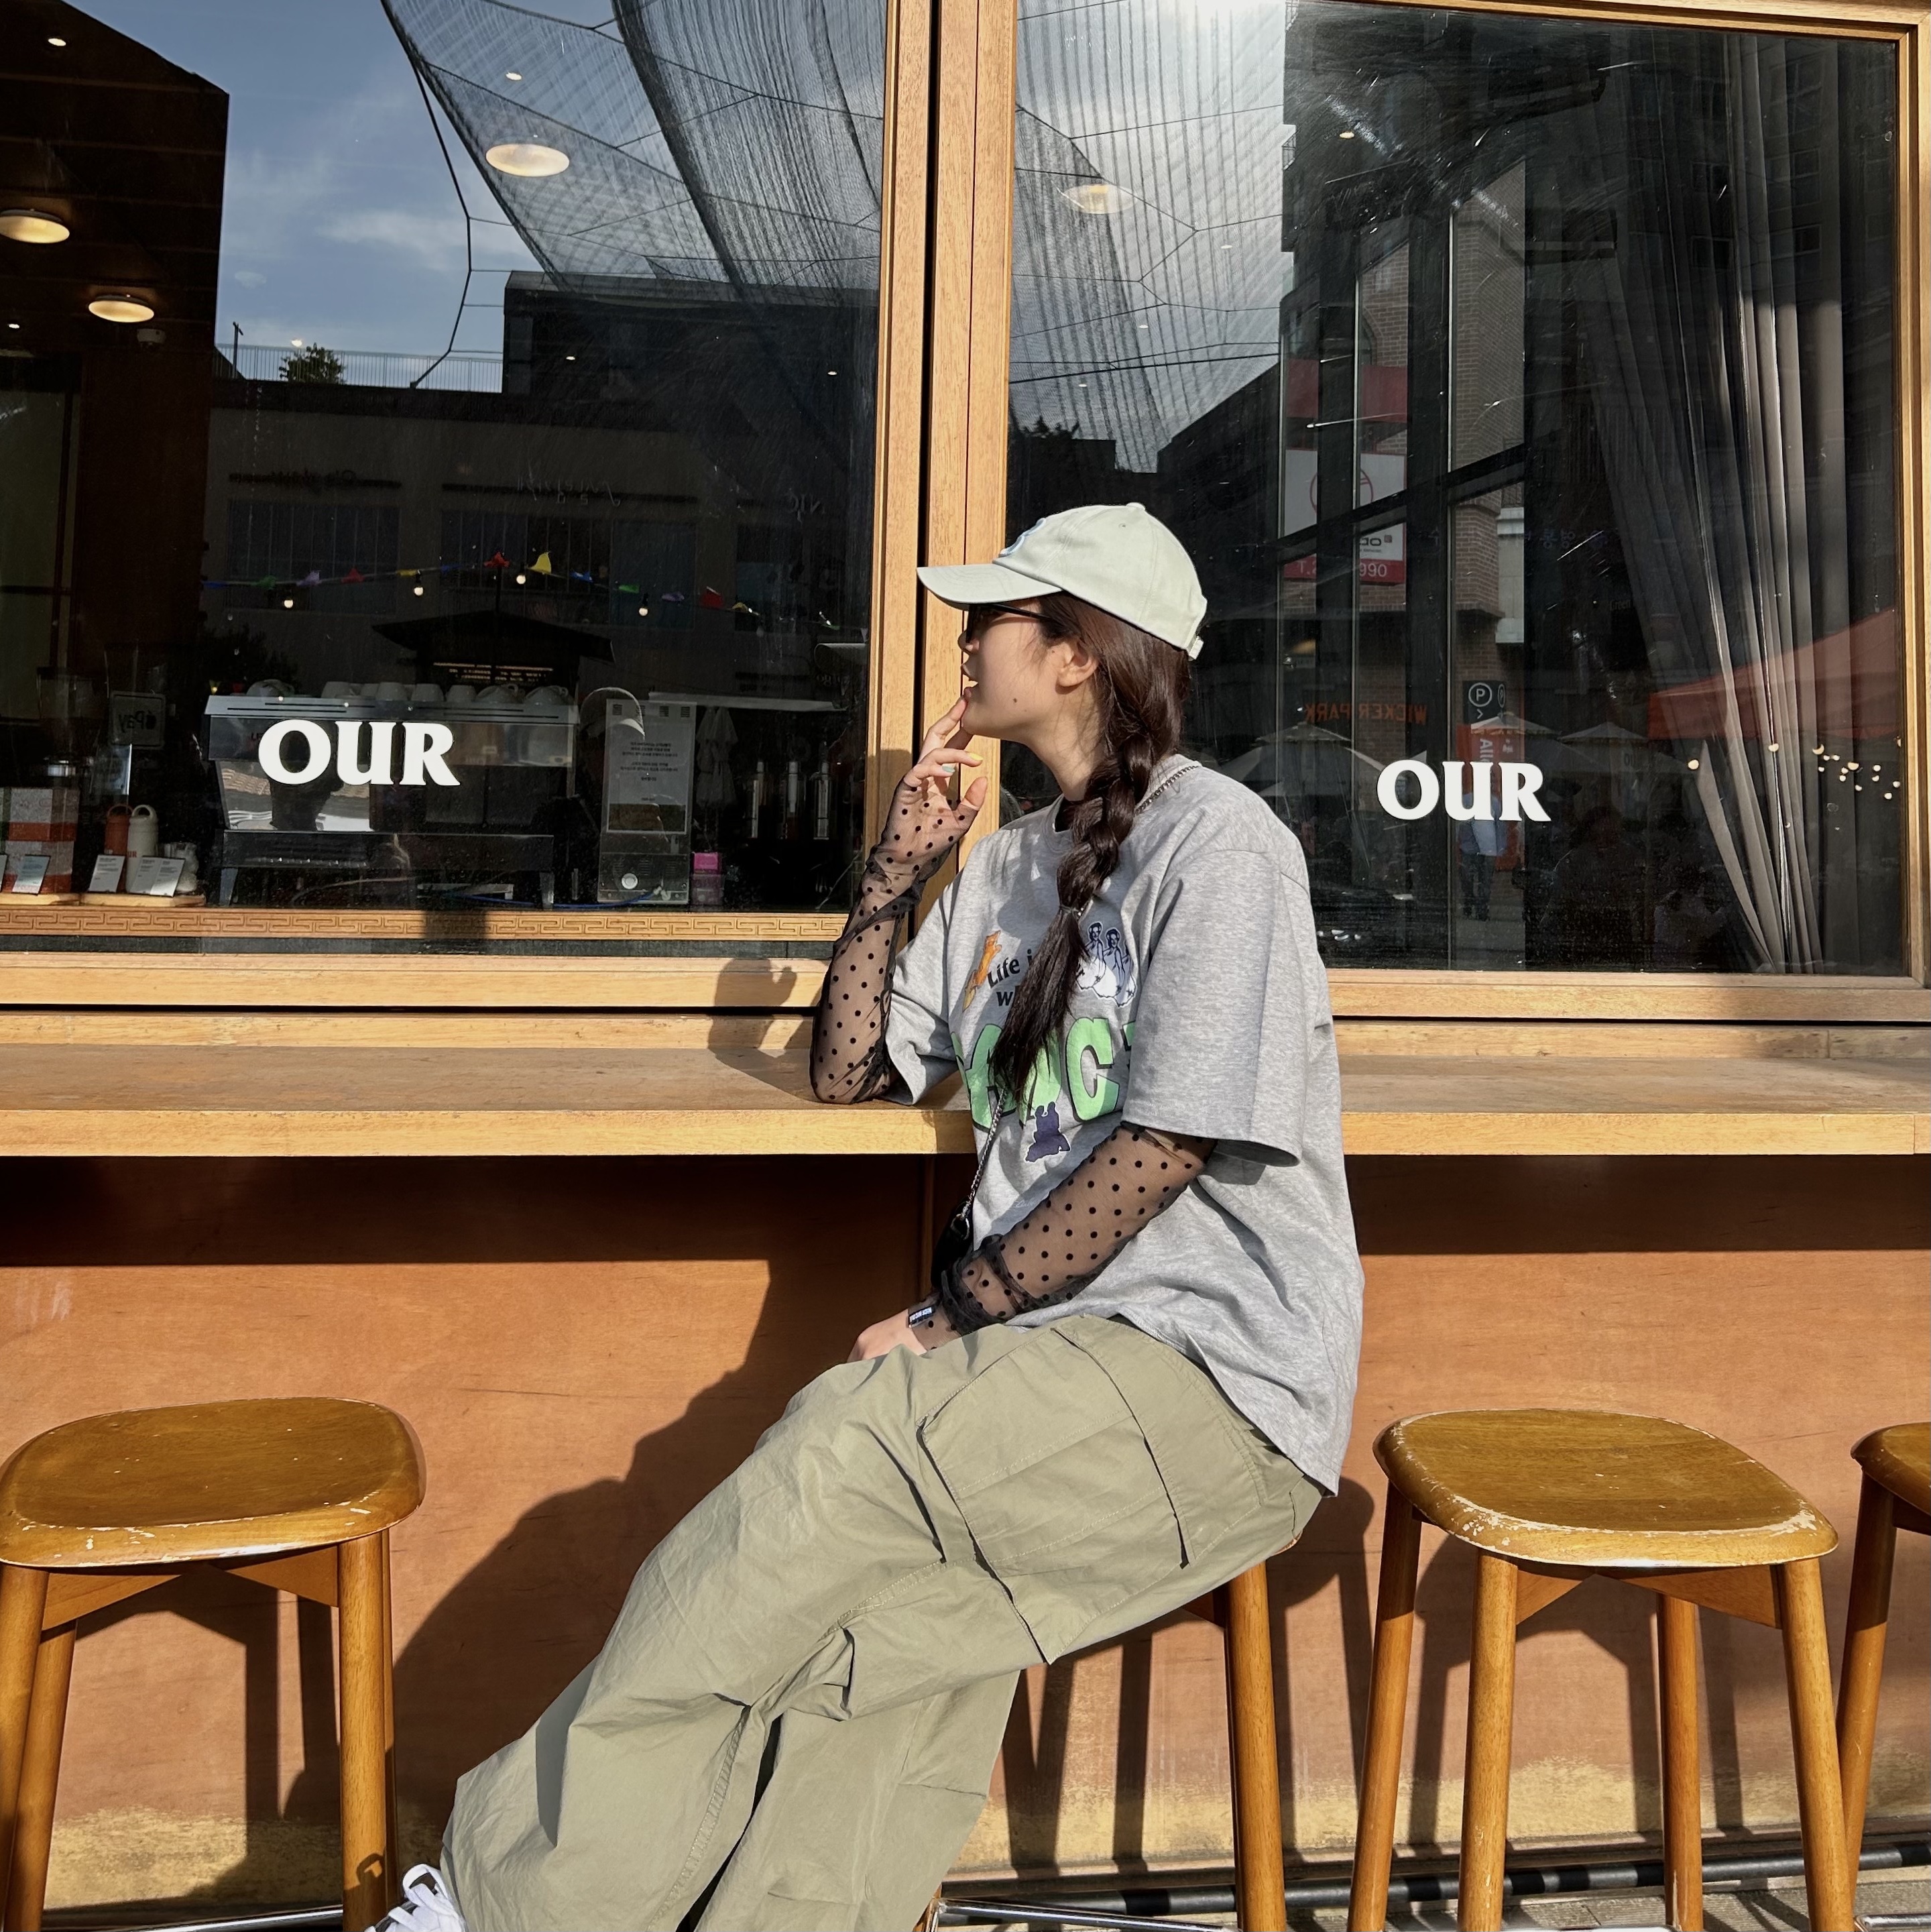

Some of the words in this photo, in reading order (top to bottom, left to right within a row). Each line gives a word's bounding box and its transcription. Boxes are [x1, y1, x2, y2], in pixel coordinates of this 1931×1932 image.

[259, 720, 461, 786] OUR
[1377, 760, 1552, 821] OUR
[987, 956, 1020, 988] Life
